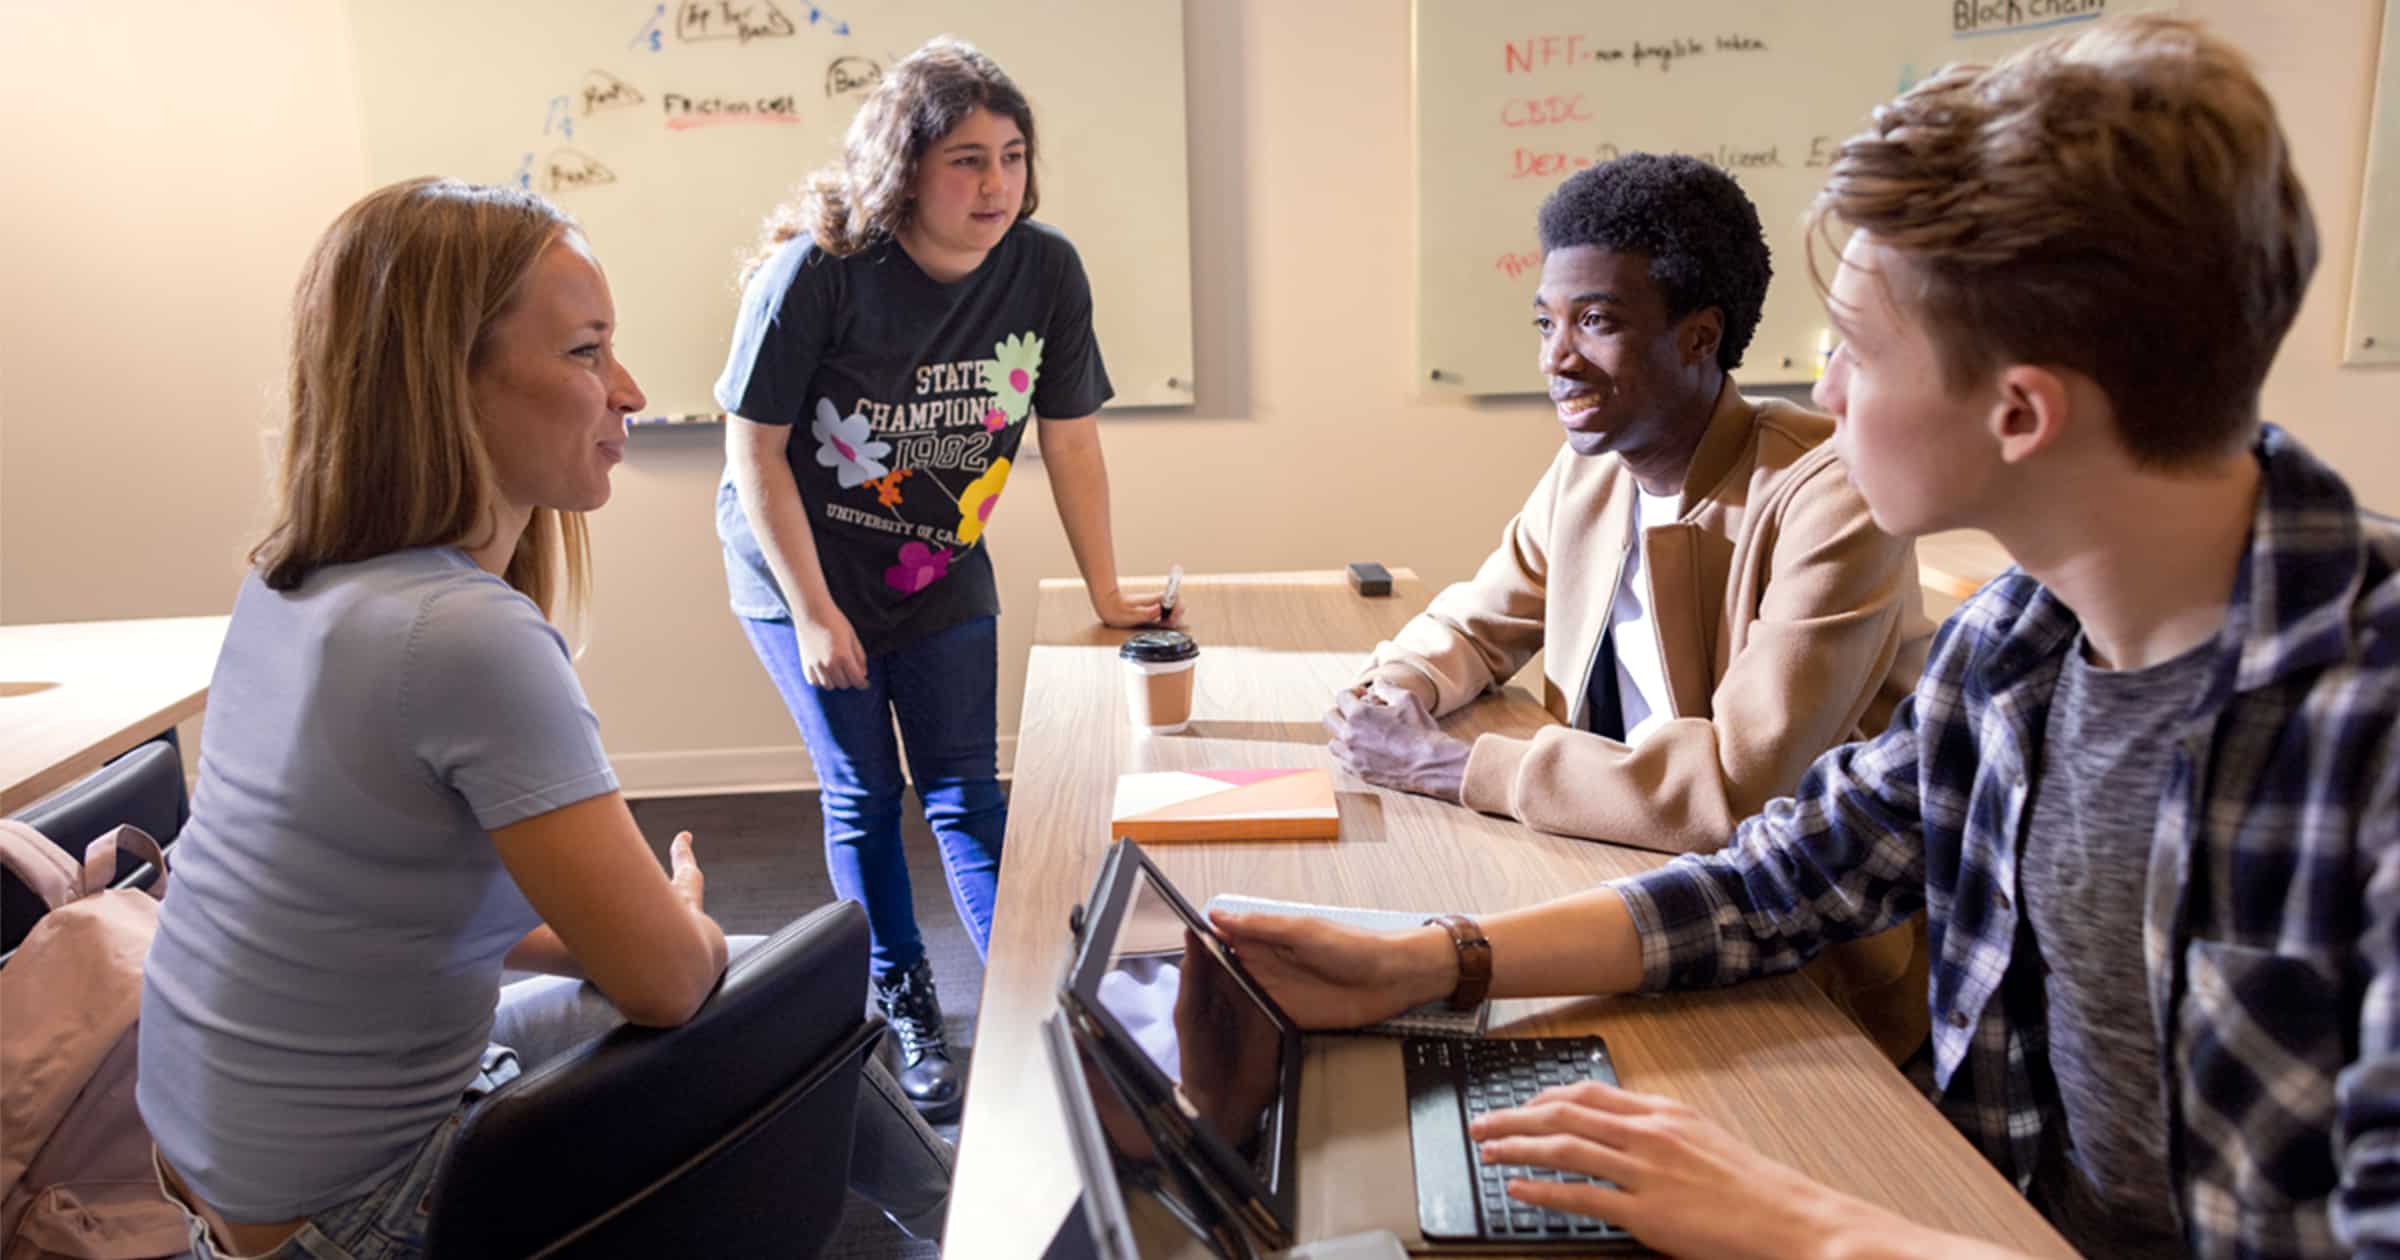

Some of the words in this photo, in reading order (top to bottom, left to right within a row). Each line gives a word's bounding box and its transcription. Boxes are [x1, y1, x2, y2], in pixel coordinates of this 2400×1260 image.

[916, 360, 990, 394] STATE
[891, 431, 993, 472] 1982
[826, 503, 913, 535] UNIVERSITY
[916, 524, 935, 540] OF
